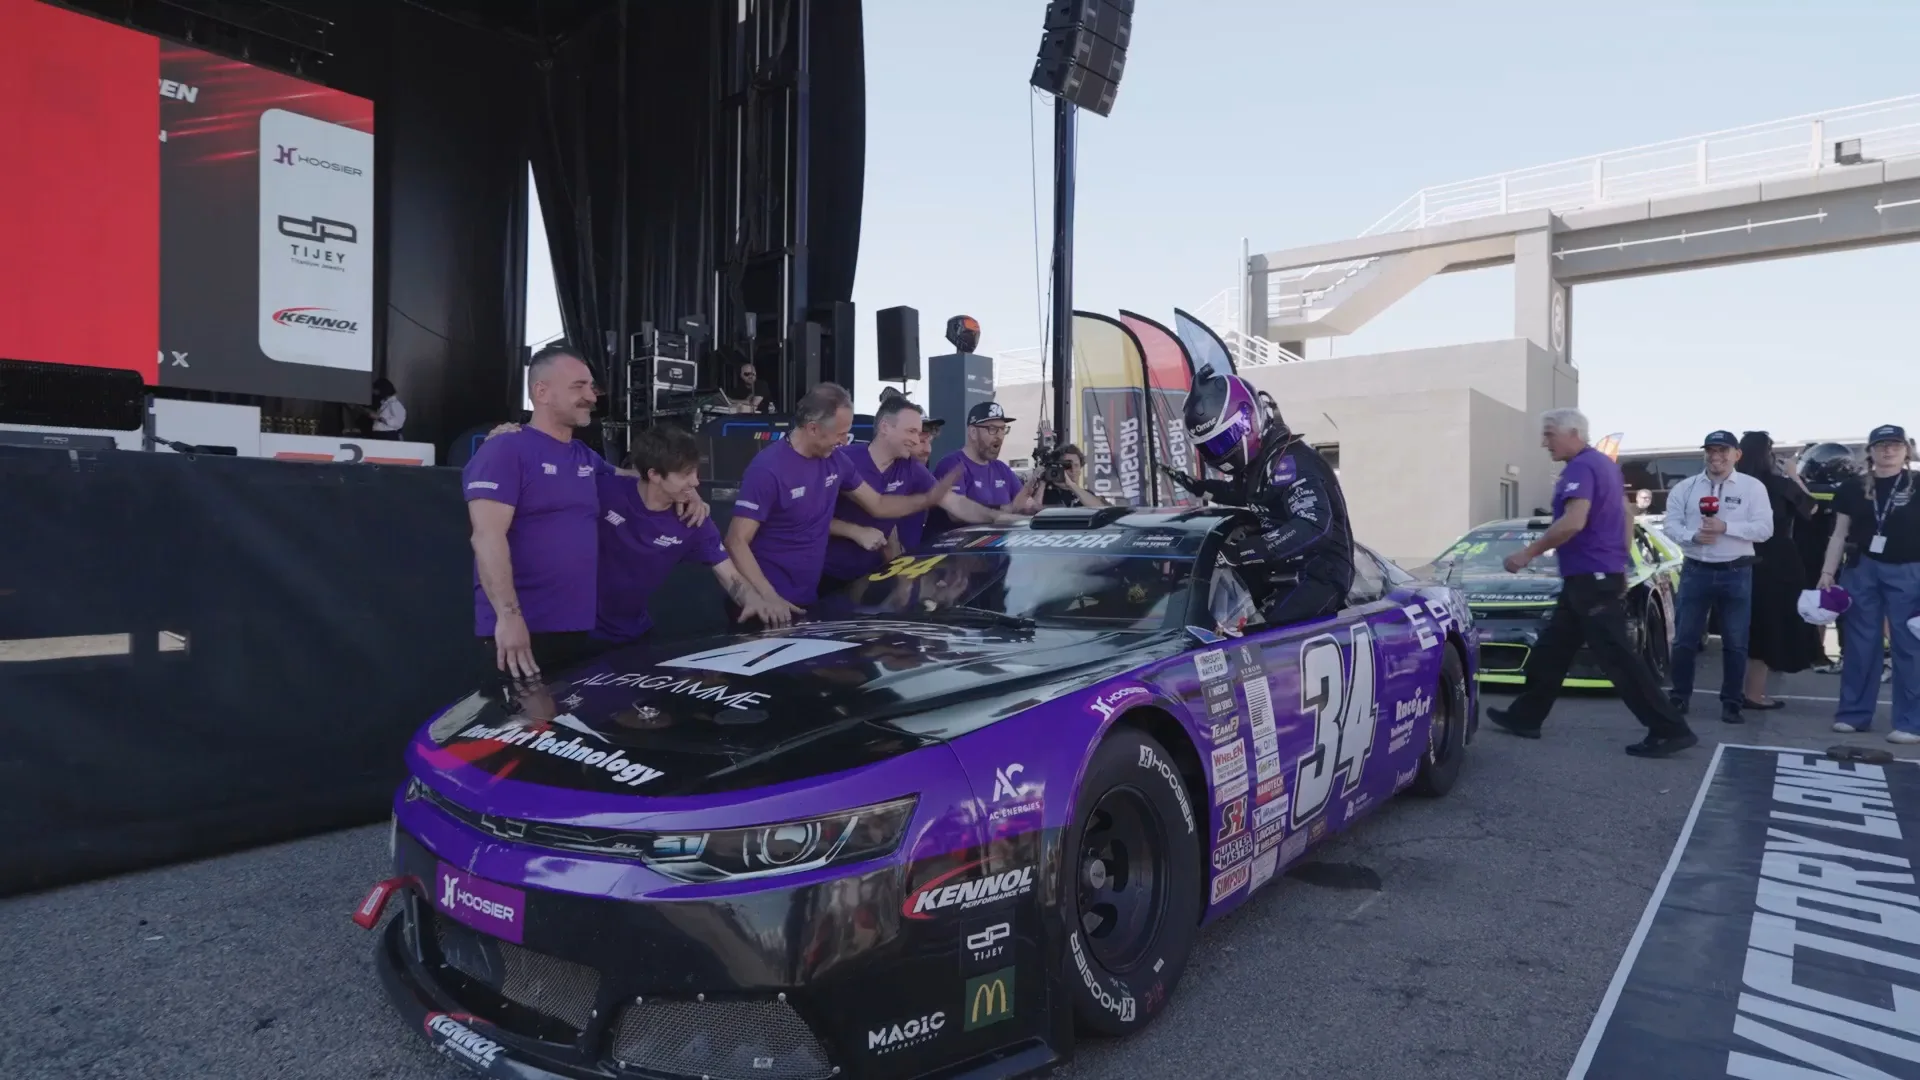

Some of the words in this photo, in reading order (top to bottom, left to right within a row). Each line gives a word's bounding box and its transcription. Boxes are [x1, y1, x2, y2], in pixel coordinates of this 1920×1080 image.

[158, 79, 199, 103] EN
[298, 154, 363, 177] HOOSIER
[290, 244, 346, 264] TIJEY
[278, 312, 358, 332] KENNOL
[995, 533, 1121, 549] NASCAR
[1453, 541, 1488, 555] 24
[868, 553, 948, 581] 34
[1291, 622, 1379, 830] 34
[527, 731, 665, 786] Technology
[1213, 741, 1243, 767] WHELEN
[1152, 754, 1194, 835] HOOSIER
[1769, 752, 1903, 840] LANE
[989, 811, 999, 821] AC
[1001, 801, 1041, 818] ENERGIES
[1220, 842, 1251, 869] MASTER
[912, 866, 1033, 914] KENNOL
[960, 889, 1019, 910] PERFORMANCE
[1019, 885, 1031, 894] OIL
[457, 888, 514, 922] HOOSIER
[974, 946, 1004, 961] TIJEY
[1070, 929, 1122, 1015] HOOSIER
[427, 1014, 505, 1062] KENNOL
